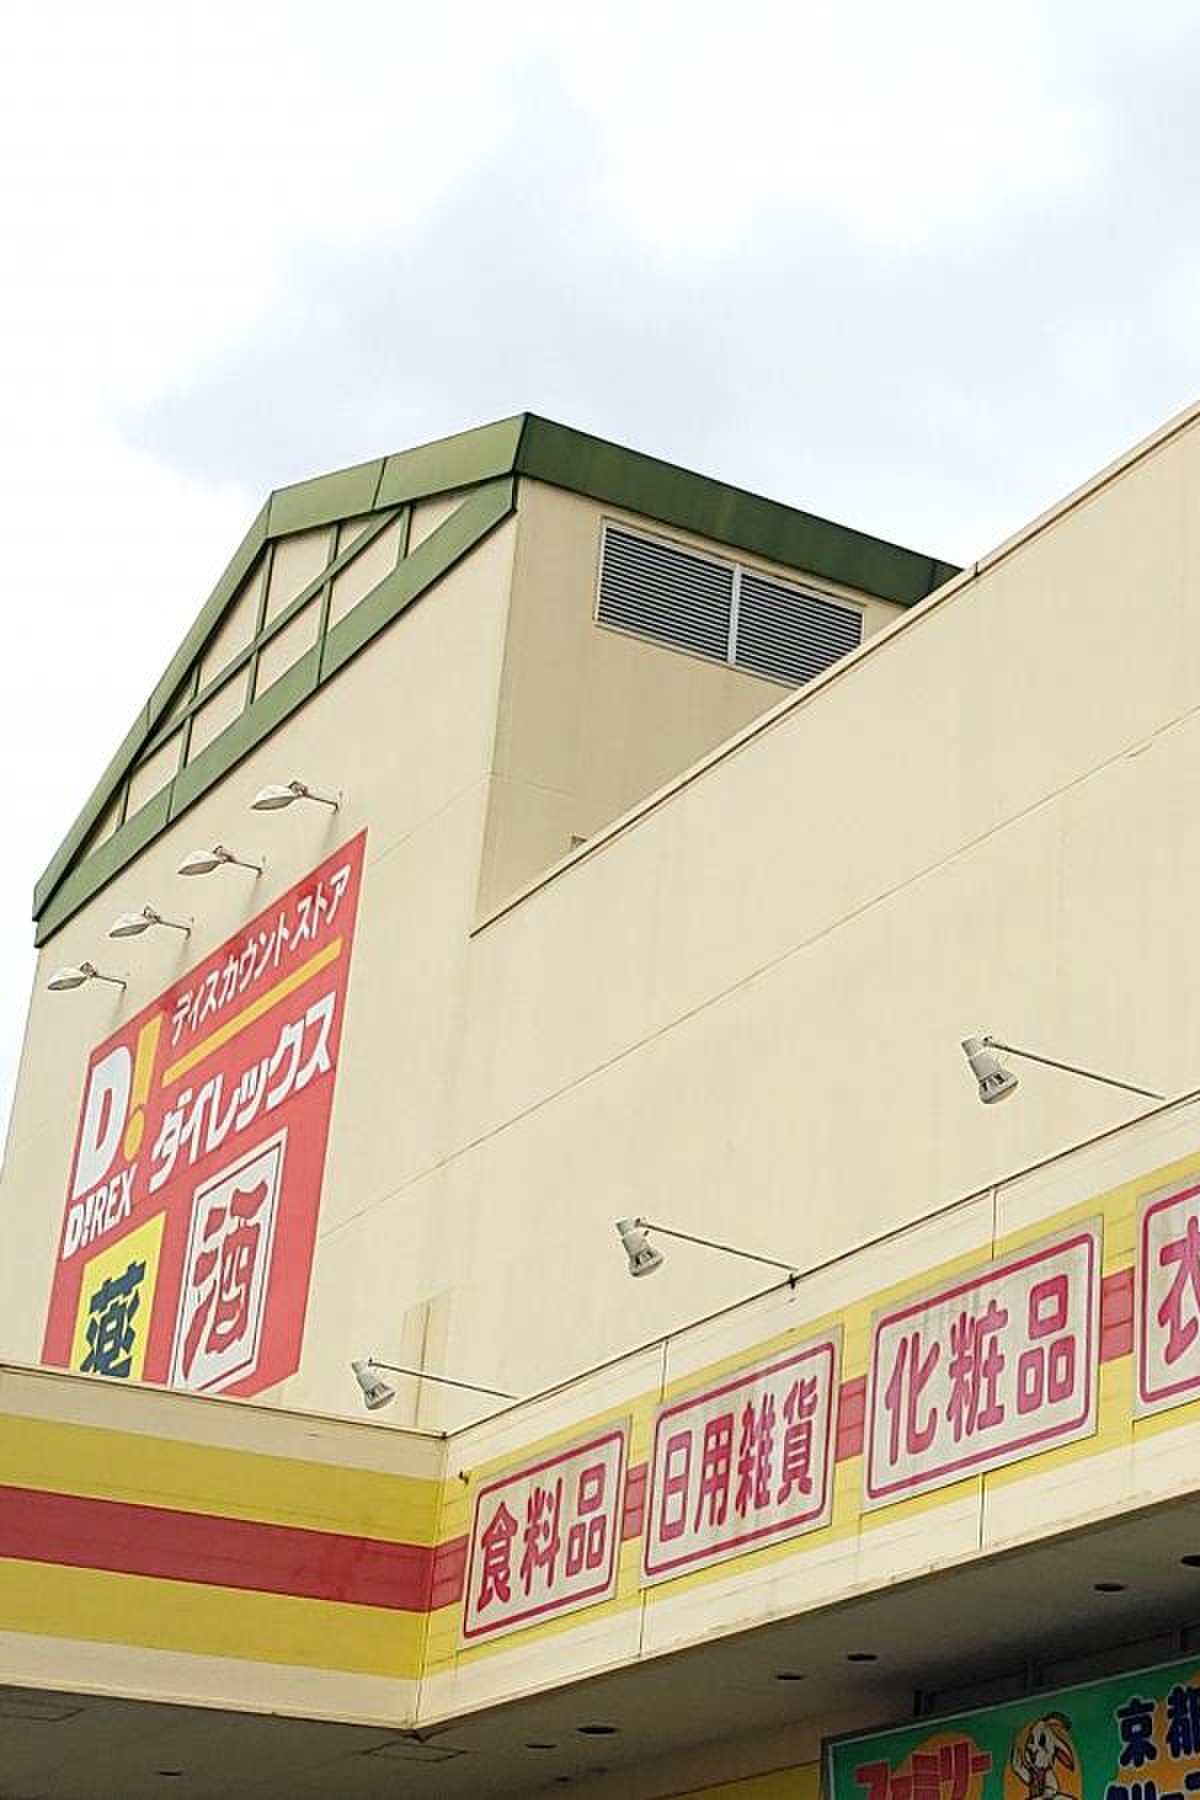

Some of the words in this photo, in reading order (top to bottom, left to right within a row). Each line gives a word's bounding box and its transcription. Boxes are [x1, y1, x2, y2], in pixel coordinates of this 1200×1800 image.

[171, 863, 351, 1046] ディスカウントストア
[149, 990, 336, 1194] ダイレックス
[182, 1178, 269, 1382] 酒
[884, 1272, 1075, 1466] 化粧品
[477, 1461, 607, 1613] 食料品
[658, 1375, 819, 1543] 日用雑貨
